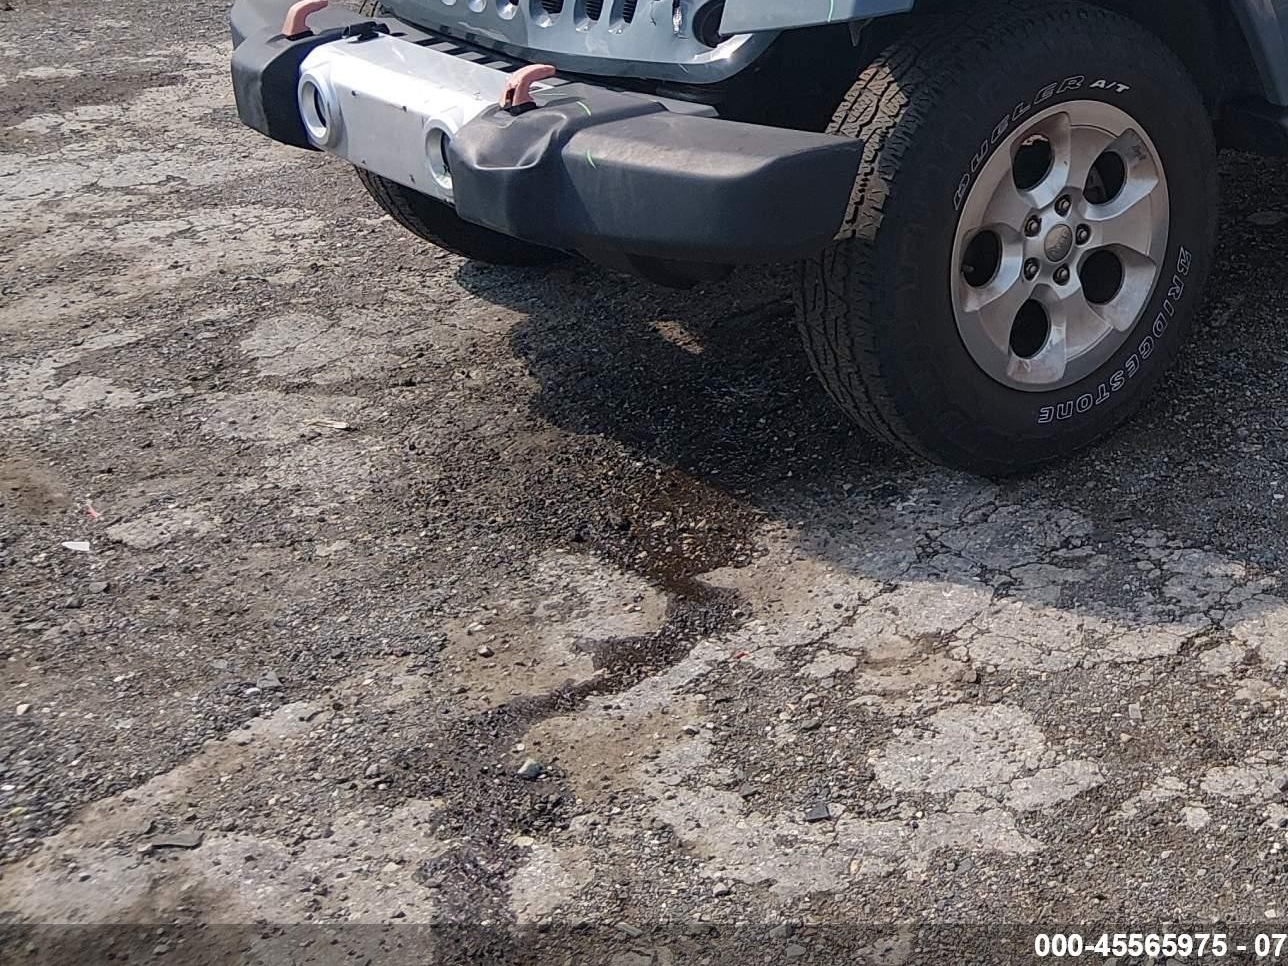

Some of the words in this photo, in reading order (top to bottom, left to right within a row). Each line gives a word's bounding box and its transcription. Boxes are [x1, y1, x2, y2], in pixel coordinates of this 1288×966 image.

[953, 75, 1085, 210] DUELER
[1089, 79, 1131, 93] A/T
[1037, 246, 1192, 424] BRIDGESTONE
